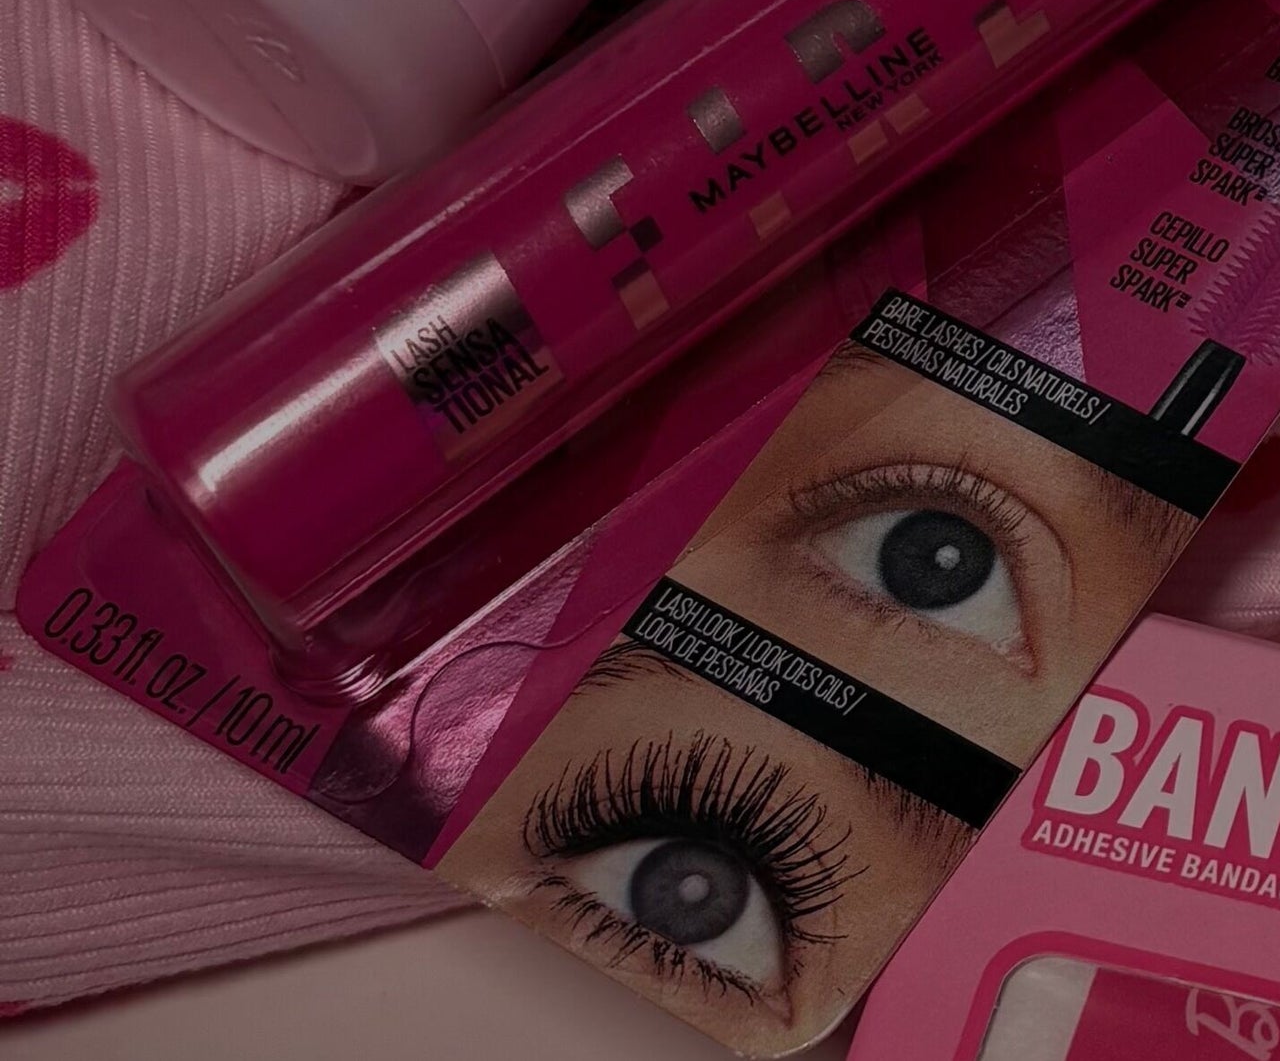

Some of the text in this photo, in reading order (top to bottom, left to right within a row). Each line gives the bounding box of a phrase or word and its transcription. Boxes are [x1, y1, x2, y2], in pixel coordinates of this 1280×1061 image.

[688, 27, 939, 213] MAYBELLINE
[836, 49, 945, 133] NEW YORK
[1208, 134, 1276, 179] SUPER
[1129, 237, 1198, 285] SUPER
[1149, 210, 1230, 264] CEPILLO
[391, 316, 458, 375] LASH
[411, 319, 521, 404] SENSA
[433, 340, 550, 437] TIONAL
[861, 318, 1029, 416] PESTAÑAS NATURALES
[880, 297, 1112, 427] BARE LASHES / CILS NATURELS /
[43, 586, 322, 775] 0.33 fl. oz. / 10 ml
[634, 610, 781, 707] LOOK DE PESTAÑAS
[653, 586, 700, 625] LASH
[694, 610, 743, 650] LOOK
[742, 631, 790, 679] LOOK
[784, 651, 817, 692] DES
[815, 671, 857, 712] CILS
[845, 690, 868, 717] /
[1030, 819, 1174, 875] ADHESIVE
